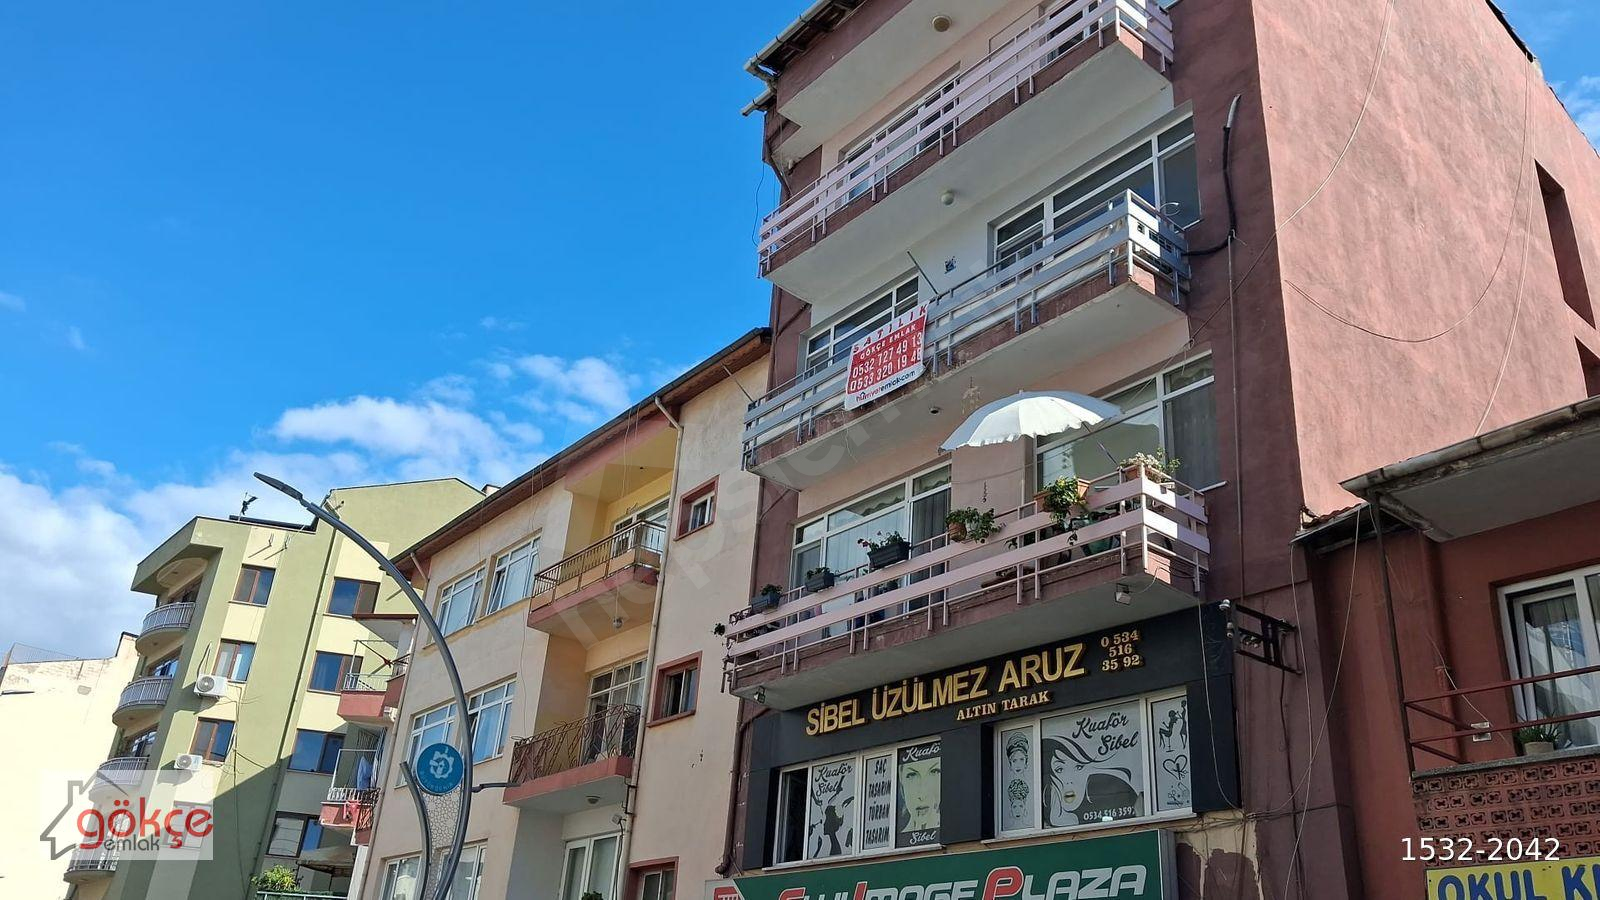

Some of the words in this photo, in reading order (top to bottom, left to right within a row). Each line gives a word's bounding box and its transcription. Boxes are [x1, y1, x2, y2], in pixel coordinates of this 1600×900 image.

[860, 340, 886, 360] GÖKÇE
[889, 323, 916, 343] EMLAK
[852, 358, 875, 379] 0532
[877, 347, 894, 367] 727
[896, 339, 908, 355] 49
[850, 373, 874, 392] 0533
[876, 362, 893, 381] 320
[897, 354, 908, 370] 19
[1100, 636, 1110, 648] 0
[1113, 630, 1140, 645] 534
[1109, 643, 1133, 658] 516
[1101, 658, 1119, 671] 35
[1122, 654, 1140, 667] 92
[805, 699, 866, 737] SİBEL
[871, 666, 989, 721] ÜZÜLMEZ
[998, 642, 1085, 694] ARUZ
[956, 701, 997, 722] ALTIN
[1001, 690, 1050, 711] TARAK
[1072, 712, 1129, 739] Kuaför
[1098, 731, 1139, 756] Sibel
[814, 763, 853, 783] Kuaför
[874, 758, 887, 778] SAÇ
[816, 780, 838, 797] Sibel
[868, 779, 892, 798] TASARIM
[865, 826, 890, 845] TASARIM
[909, 830, 936, 845] Sibel
[981, 864, 1147, 900] PLAZA
[1437, 869, 1548, 900] OKUL
